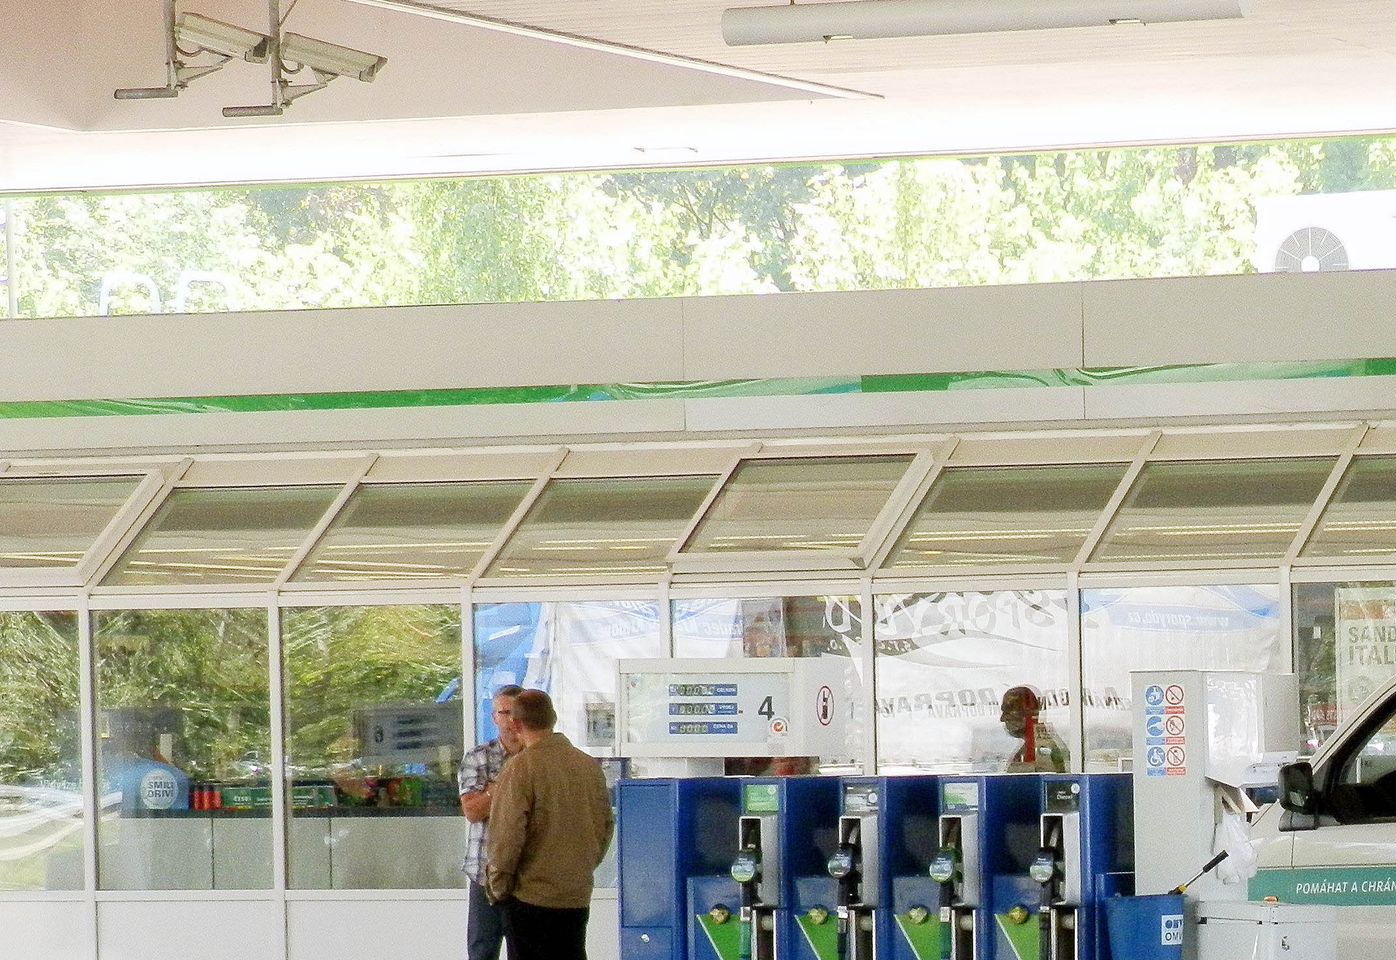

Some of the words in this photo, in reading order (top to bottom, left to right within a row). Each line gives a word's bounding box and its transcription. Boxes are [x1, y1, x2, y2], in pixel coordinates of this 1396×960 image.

[758, 696, 775, 720] 4
[1295, 878, 1349, 894] POMÁHAT
[1350, 881, 1358, 893] A
